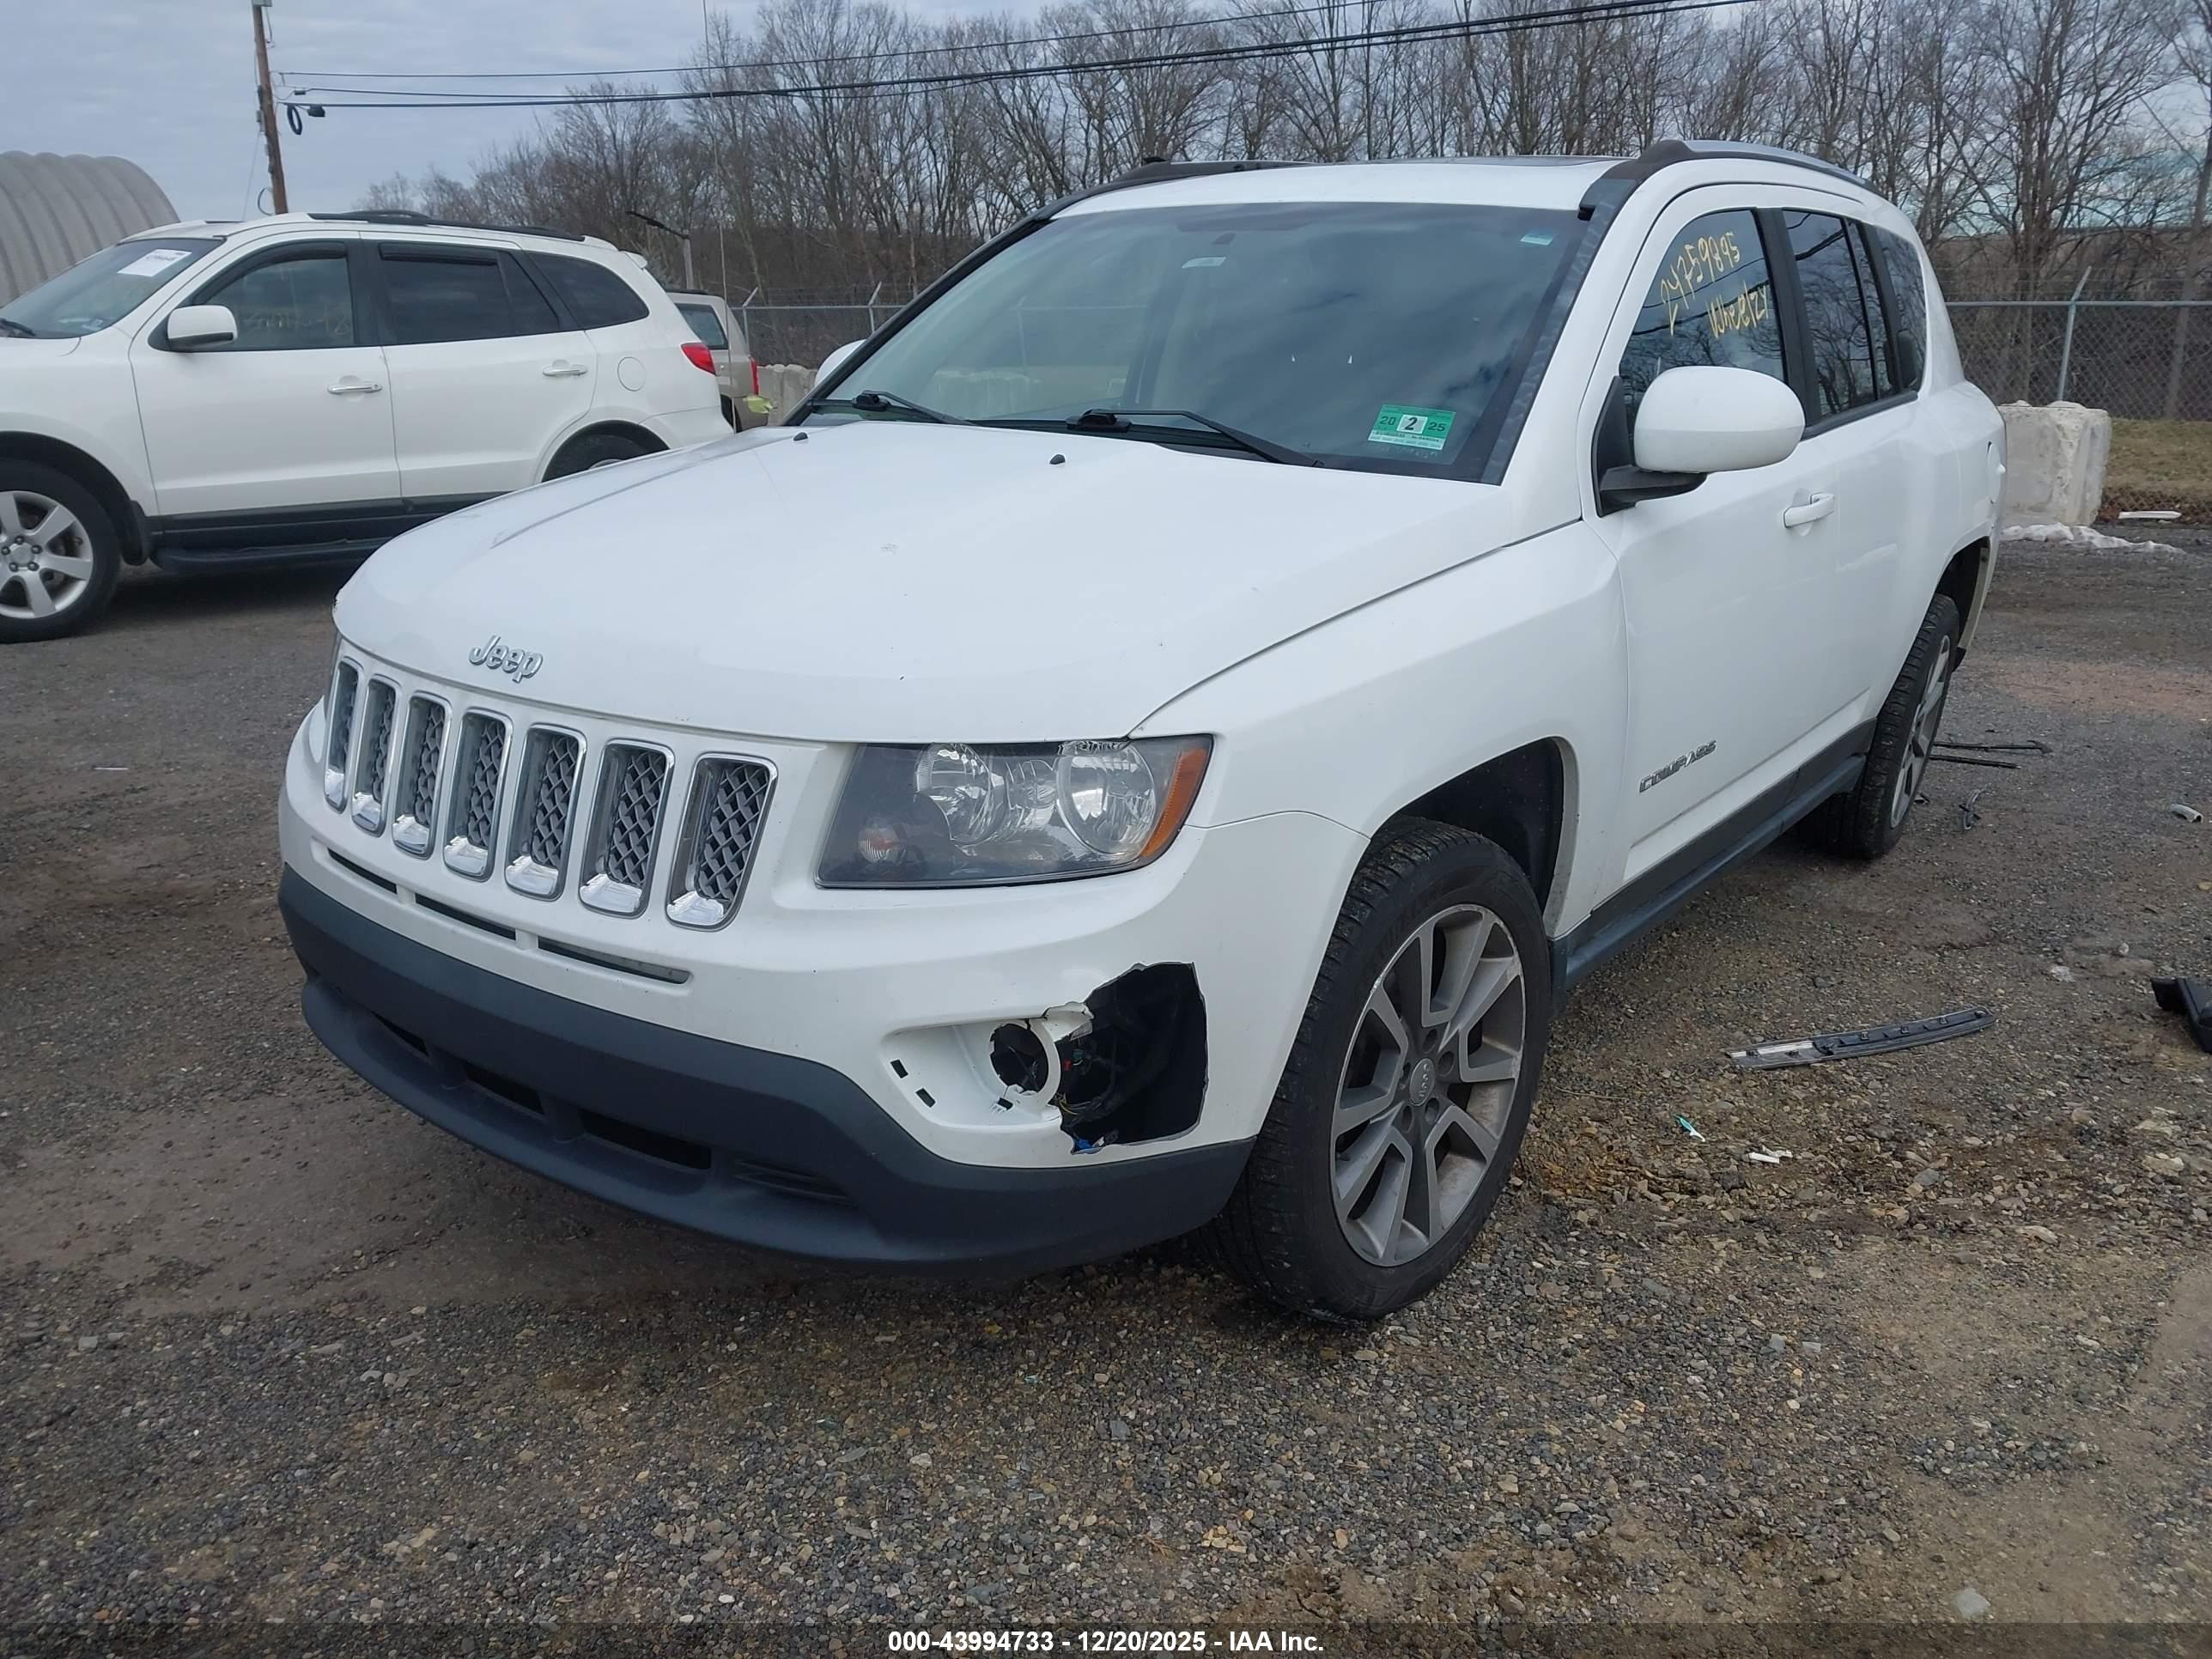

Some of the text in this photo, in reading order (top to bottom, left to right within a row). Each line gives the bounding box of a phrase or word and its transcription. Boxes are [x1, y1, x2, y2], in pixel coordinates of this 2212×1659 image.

[1379, 416, 1447, 432] 20 2 25
[469, 635, 544, 684] Jeep
